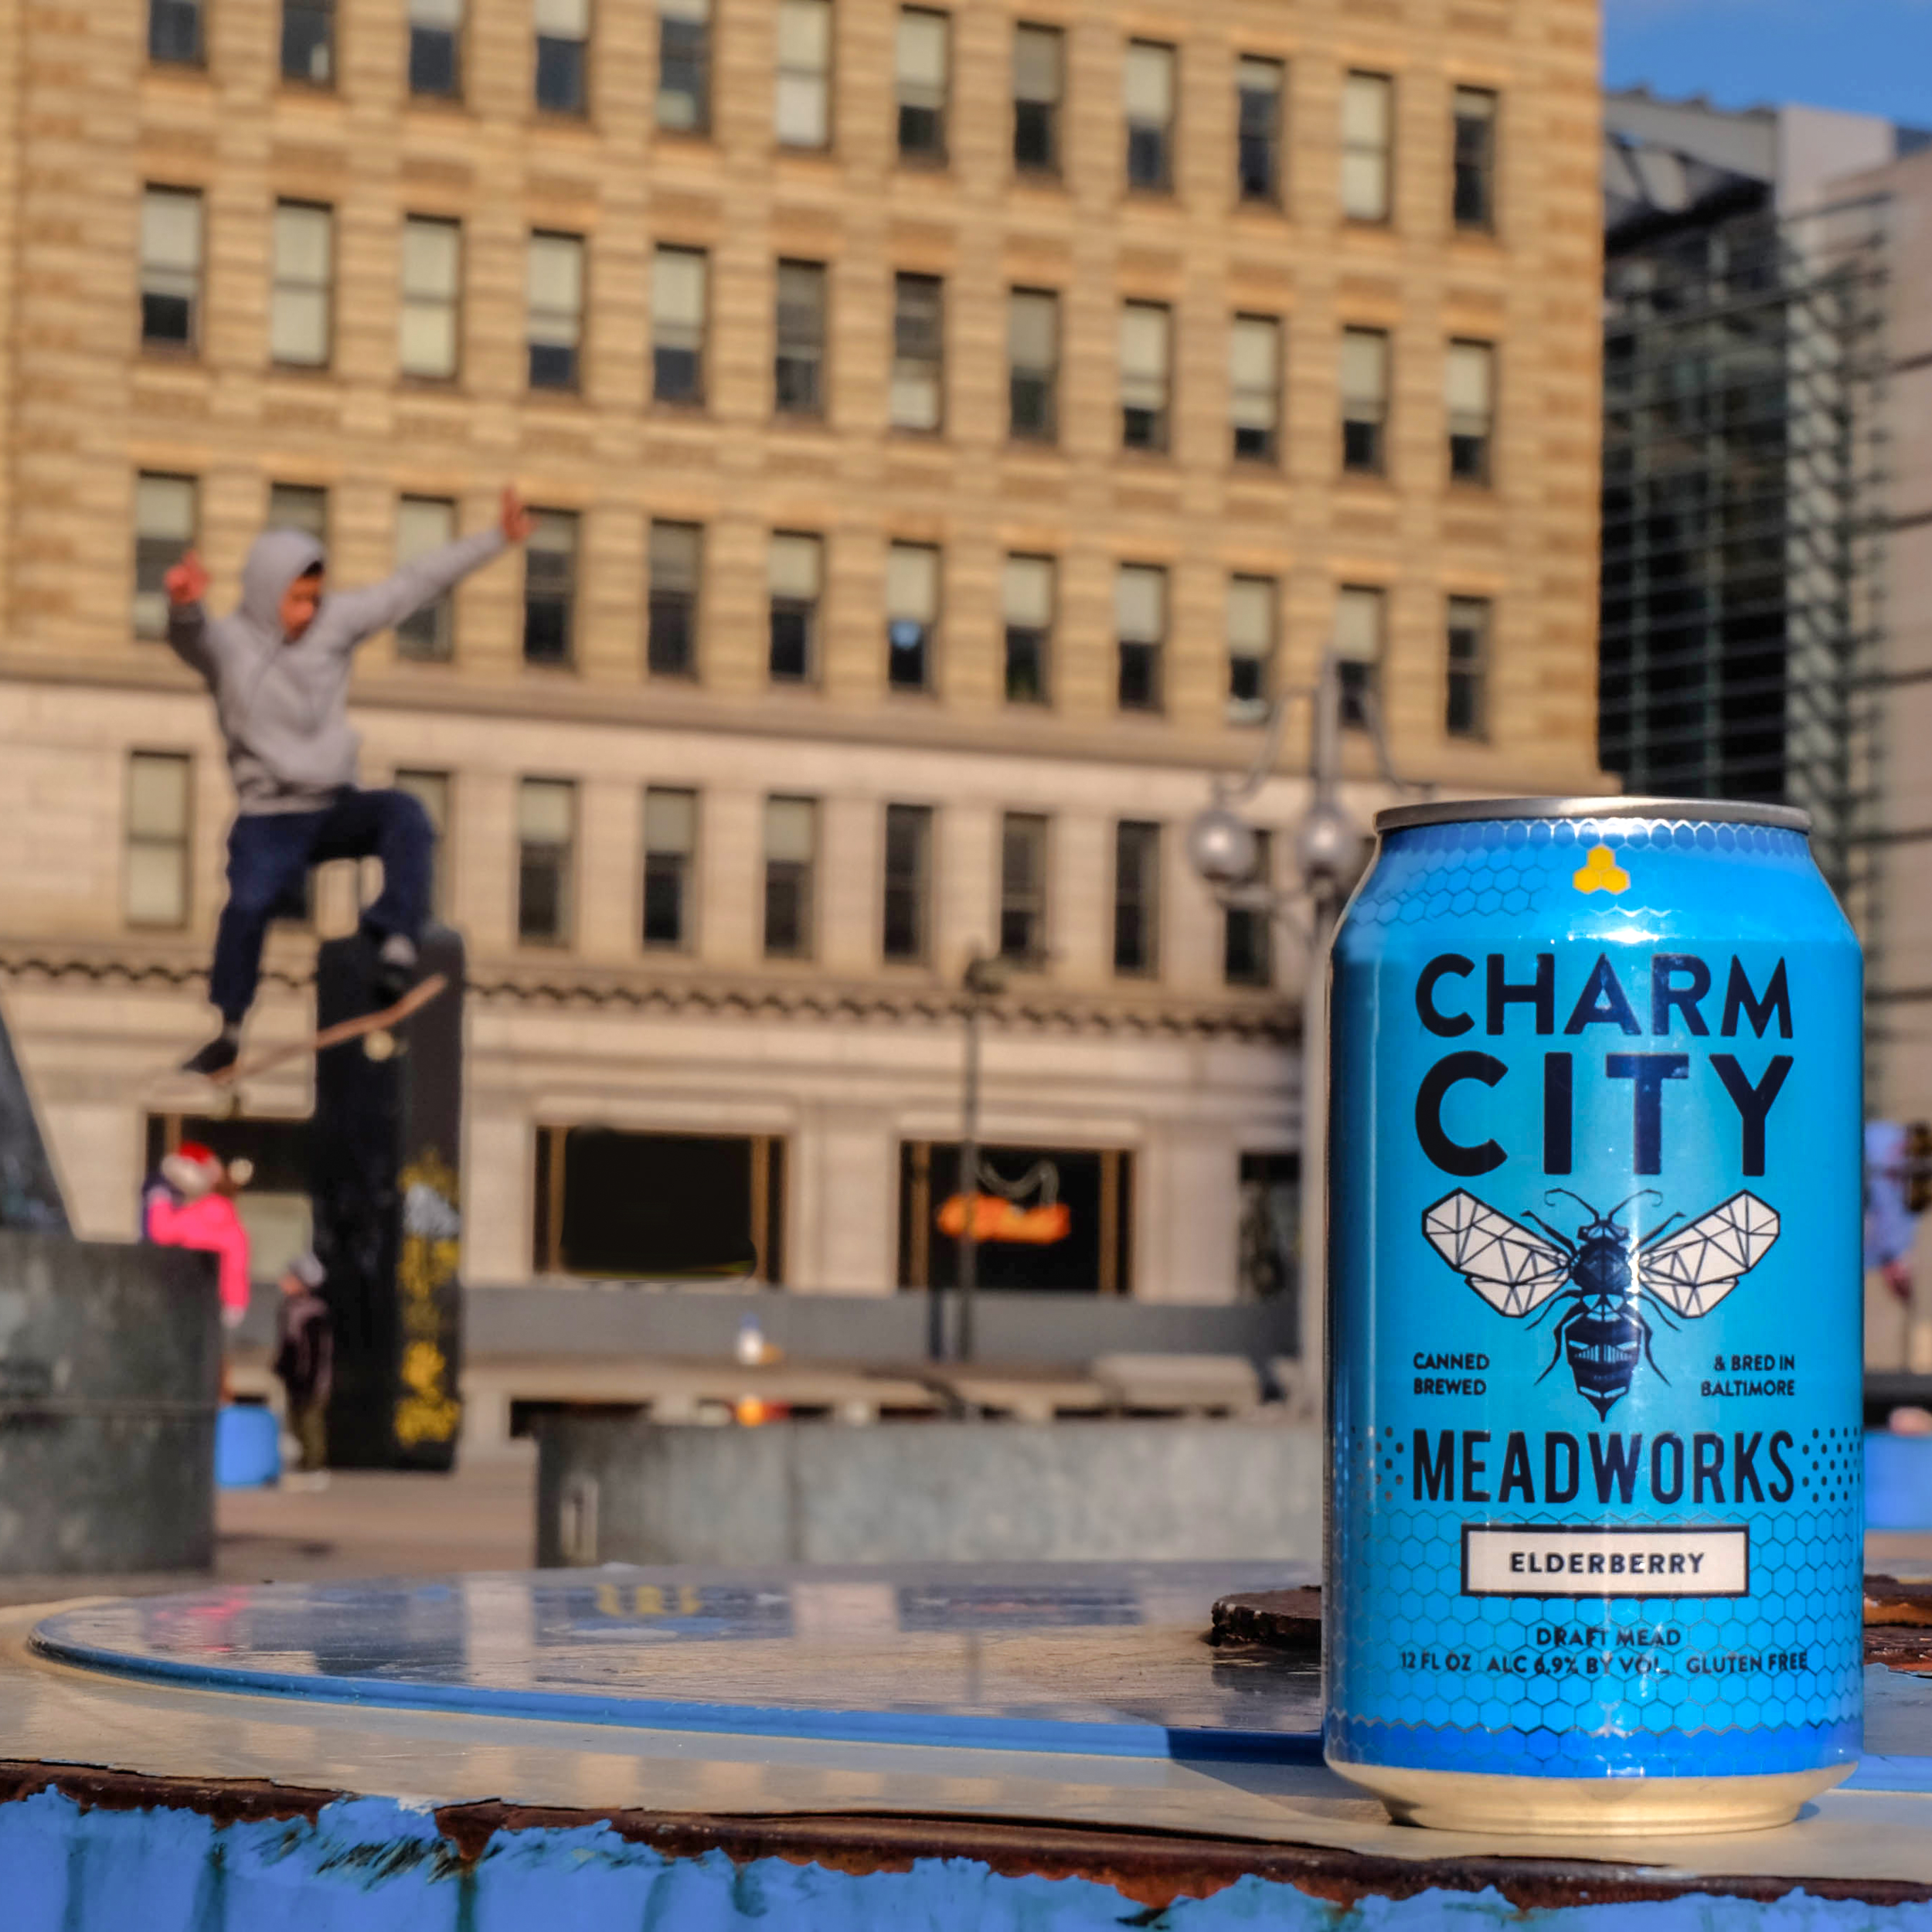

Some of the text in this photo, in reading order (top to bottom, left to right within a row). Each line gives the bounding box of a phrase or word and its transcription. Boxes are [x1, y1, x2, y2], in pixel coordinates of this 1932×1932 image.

[1415, 953, 1793, 1039] CHARM
[1415, 1052, 1794, 1177] CITY
[1413, 1352, 1490, 1370] CANNED
[1714, 1355, 1795, 1371] & BRED IN
[1413, 1378, 1487, 1396] BREWED
[1701, 1379, 1795, 1397] BALTIMORE
[1413, 1429, 1794, 1505] MEADWORKS
[1510, 1552, 1706, 1575] ELDERBERRY
[1536, 1627, 1681, 1647] DRAFT MEAD
[1401, 1652, 1415, 1668] 12
[1421, 1652, 1440, 1670] FL
[1445, 1654, 1471, 1671] OZ
[1487, 1657, 1527, 1674] ALC
[1587, 1657, 1614, 1675] BY
[1686, 1655, 1762, 1675] GLUTEN
[1768, 1652, 1808, 1671] FREE
